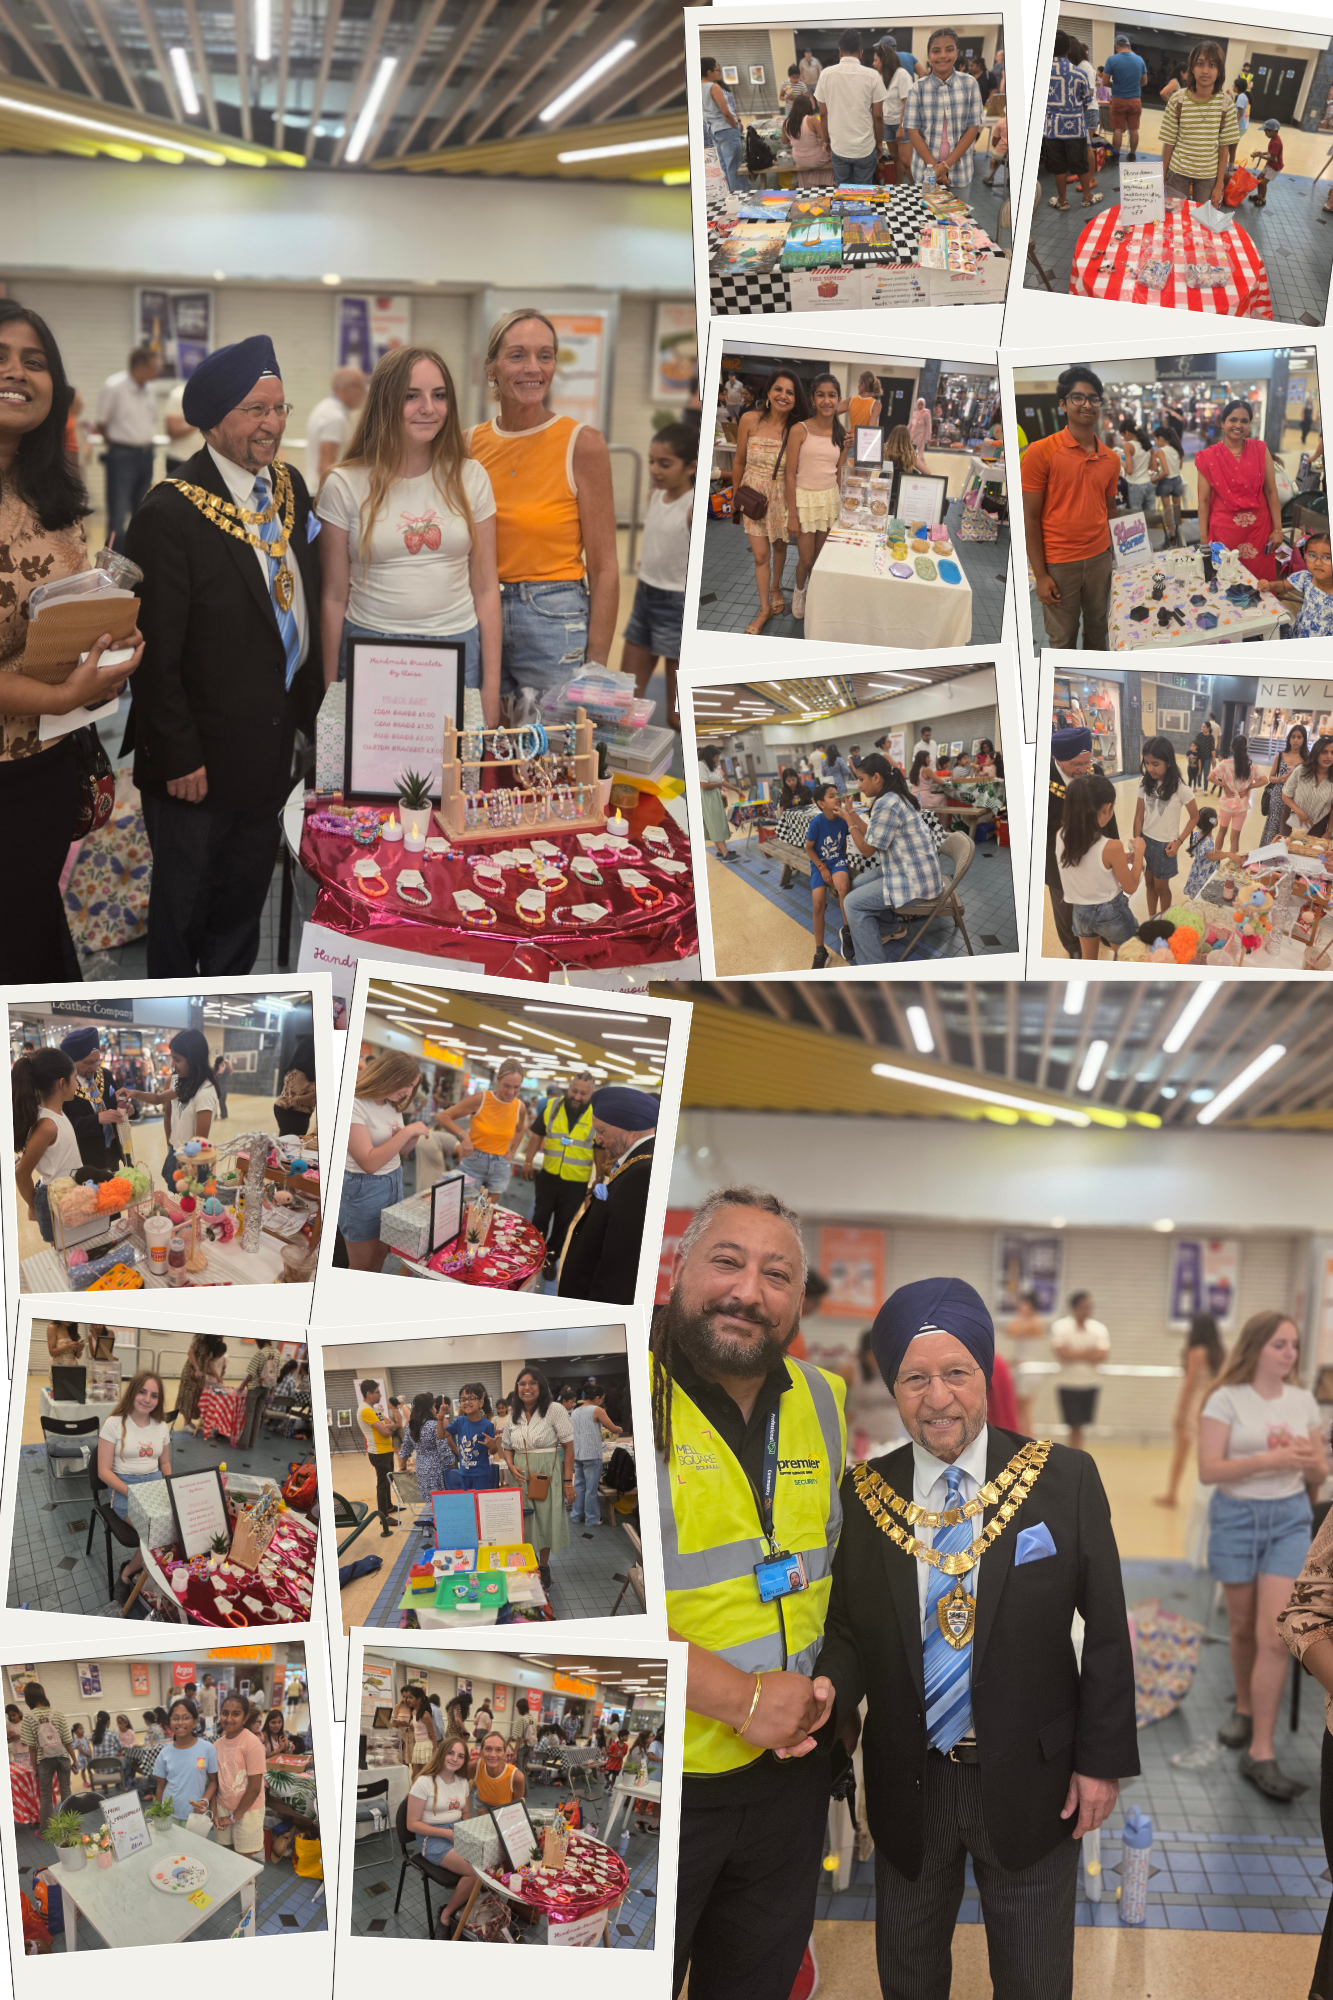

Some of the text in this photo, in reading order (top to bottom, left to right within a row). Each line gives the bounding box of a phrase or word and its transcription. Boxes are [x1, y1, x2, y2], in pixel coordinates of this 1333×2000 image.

[1261, 684, 1311, 697] NEW
[52, 1001, 133, 1019] Leather Company
[675, 1444, 701, 1455] MELL
[678, 1454, 717, 1465] SQUARE
[777, 1459, 820, 1471] premier
[176, 1665, 193, 1676] Argos
